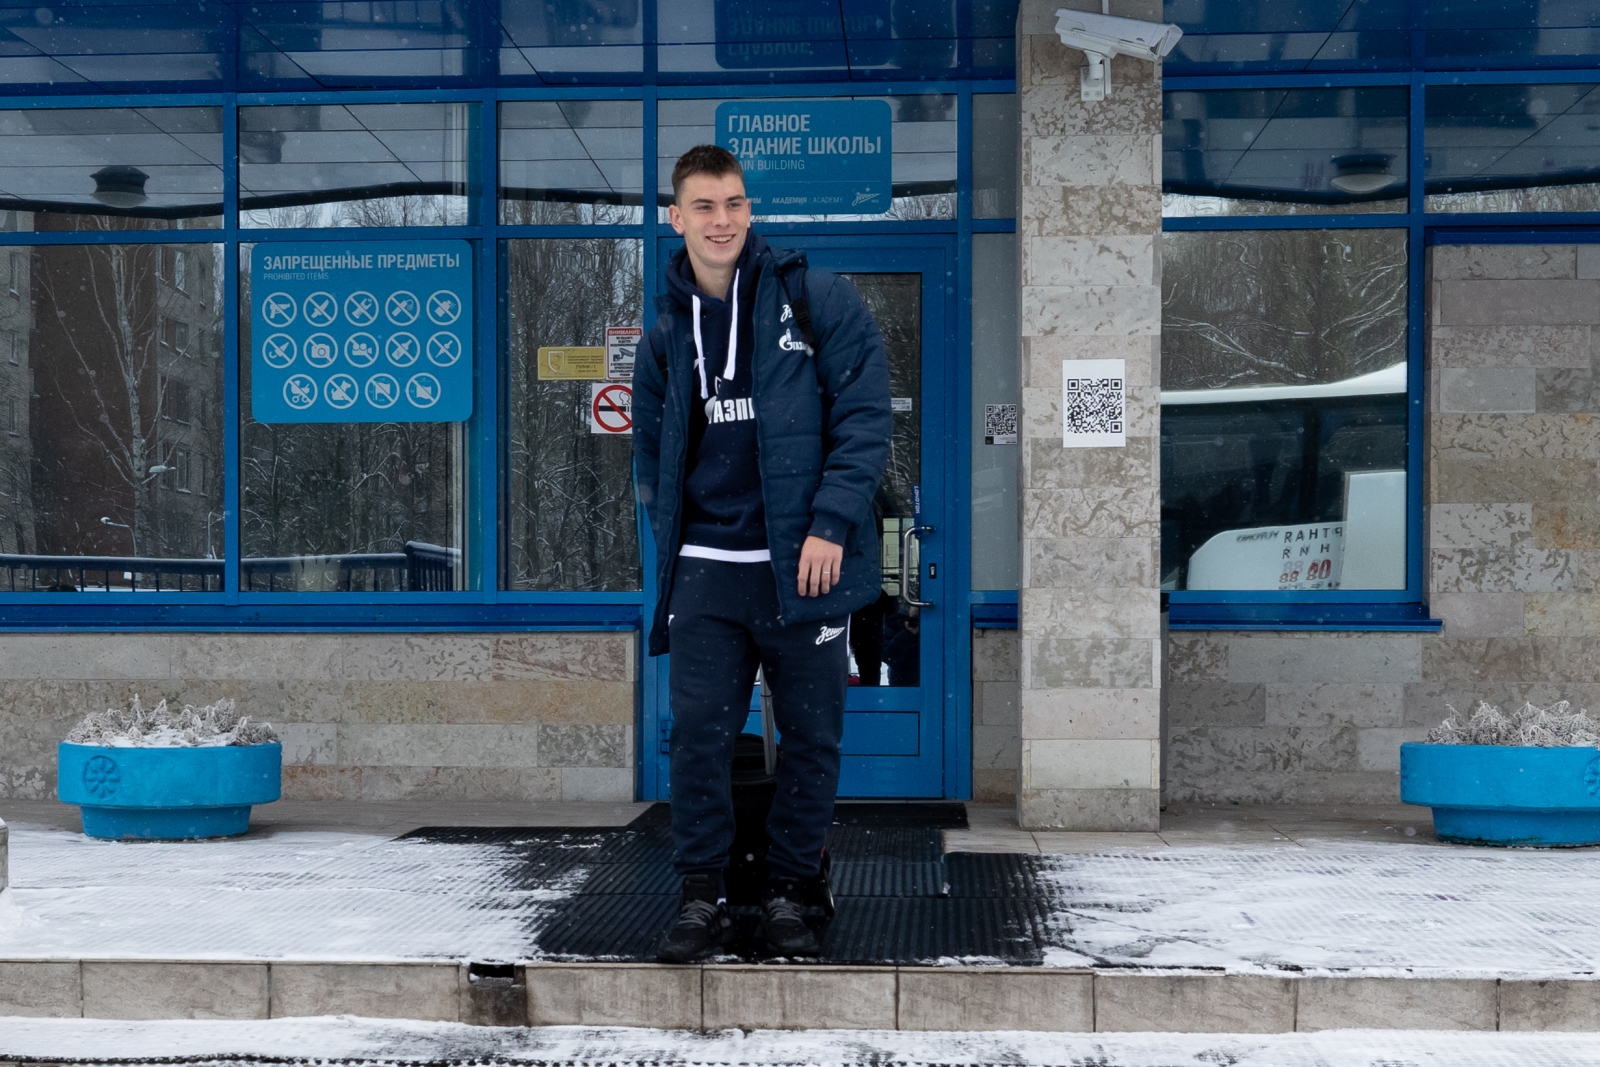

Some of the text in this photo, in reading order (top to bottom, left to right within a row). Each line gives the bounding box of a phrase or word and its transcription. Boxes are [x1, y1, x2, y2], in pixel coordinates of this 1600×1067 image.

[728, 114, 811, 133] ГЛАВНОЕ
[728, 136, 882, 158] ЗДАНИЕ ШКОЛЫ
[739, 159, 805, 170] AIN BUILDING
[772, 196, 808, 204] АКАДЕМИЯ
[812, 196, 844, 204] ACADEMY
[263, 253, 460, 272] ЗАПРЕЩЕННЫЕ ПРЕДМЕТЫ
[263, 272, 329, 281] PROHIBITED ITEMS
